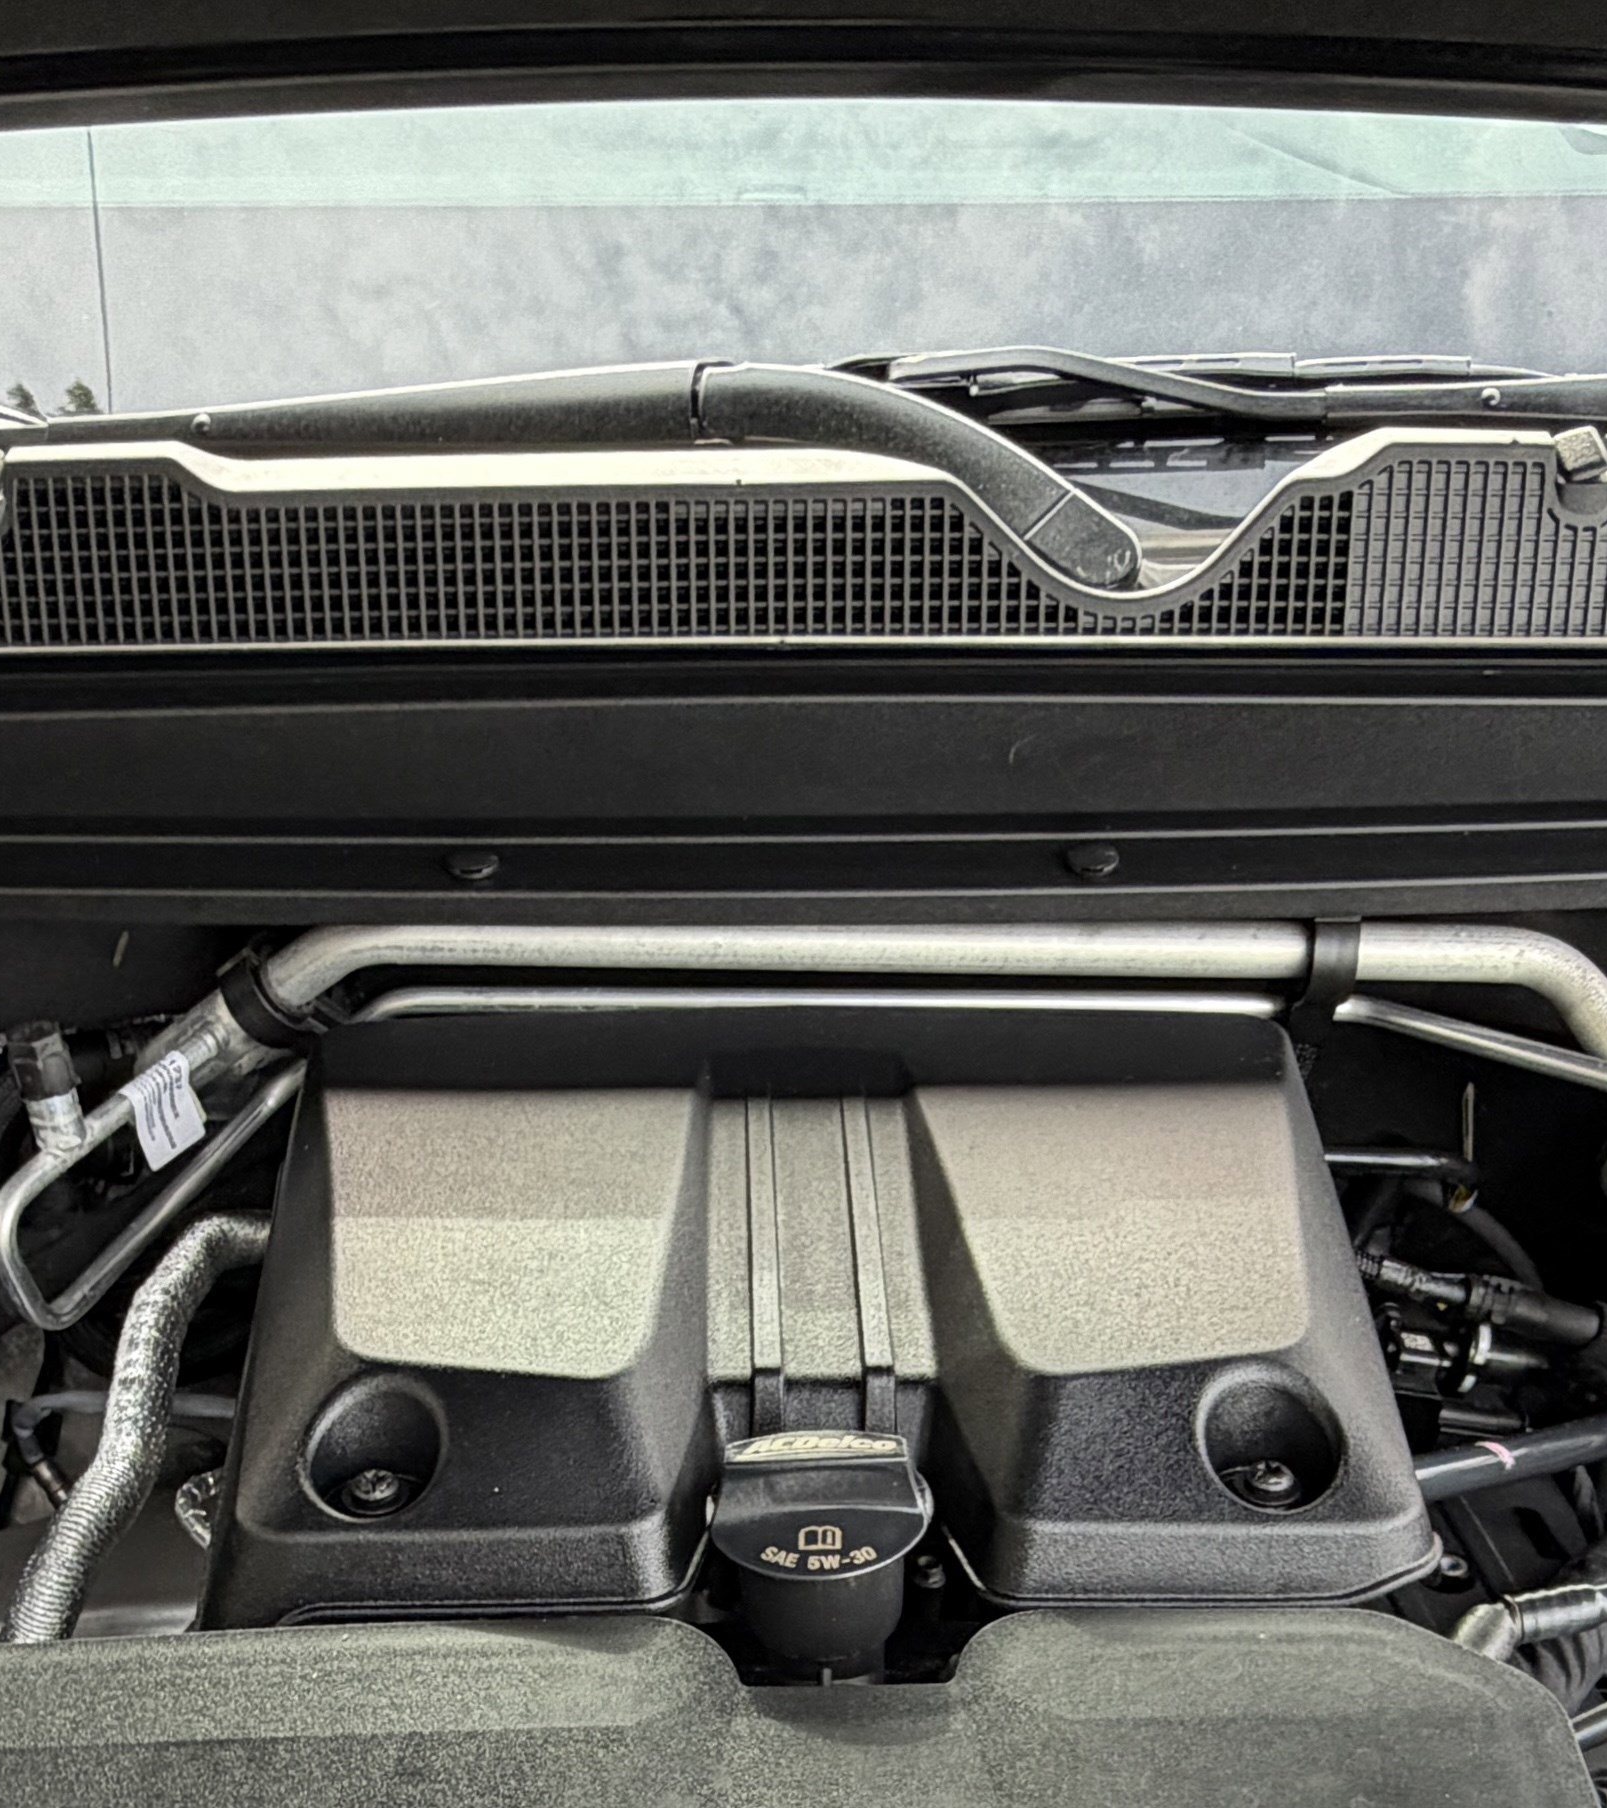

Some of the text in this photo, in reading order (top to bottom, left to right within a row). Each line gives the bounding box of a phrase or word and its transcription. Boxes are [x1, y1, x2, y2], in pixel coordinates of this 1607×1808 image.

[742, 1435, 898, 1455] ACDelco
[760, 1546, 878, 1571] SAE 5W-30
